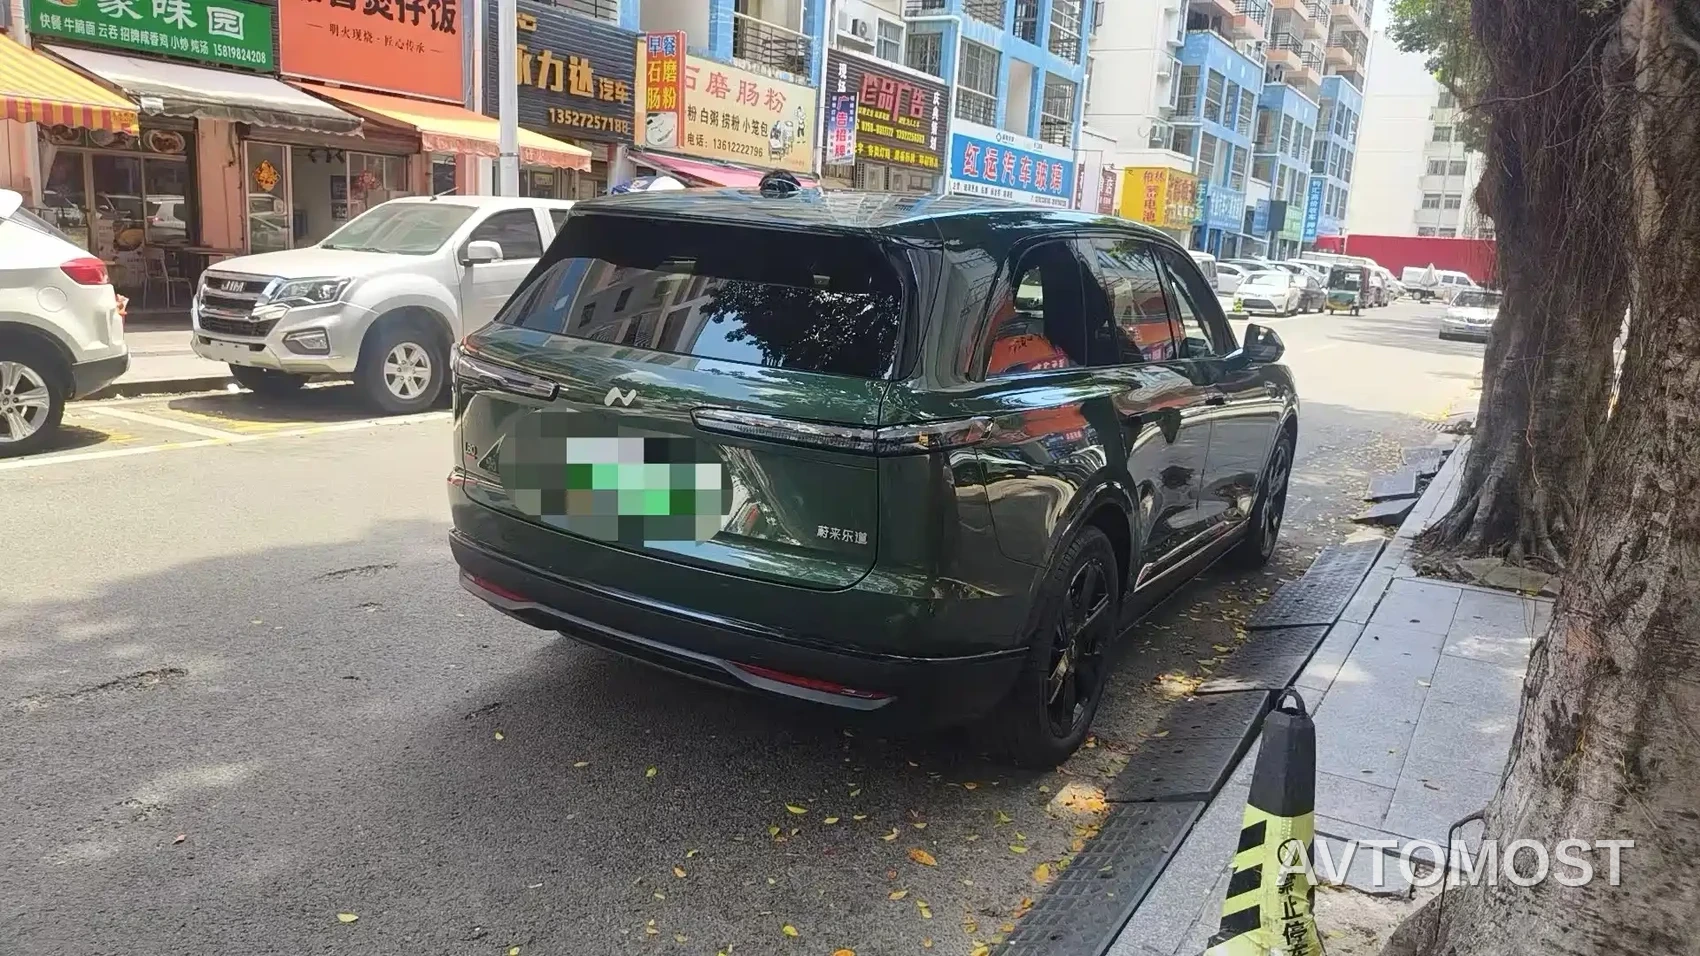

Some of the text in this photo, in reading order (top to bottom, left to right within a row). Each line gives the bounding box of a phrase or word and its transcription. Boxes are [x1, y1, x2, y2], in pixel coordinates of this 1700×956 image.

[39, 12, 62, 31] 快餐
[64, 17, 96, 36] 牛腩面
[98, 22, 119, 40] 云吞
[170, 35, 189, 51] 小炒
[213, 43, 267, 64] 15819824208
[649, 35, 677, 57] 早餐
[648, 60, 677, 83] 石磨
[646, 86, 677, 110] 肠粉
[686, 65, 787, 114] 石磨肠粉
[549, 108, 629, 134] 13527257188
[700, 107, 719, 127] 白粥
[742, 118, 769, 138] 小笼包
[713, 138, 764, 158] 13612222796
[963, 141, 1064, 195] 红运汽车玻璃
[816, 525, 868, 545] 蔚来乐道
